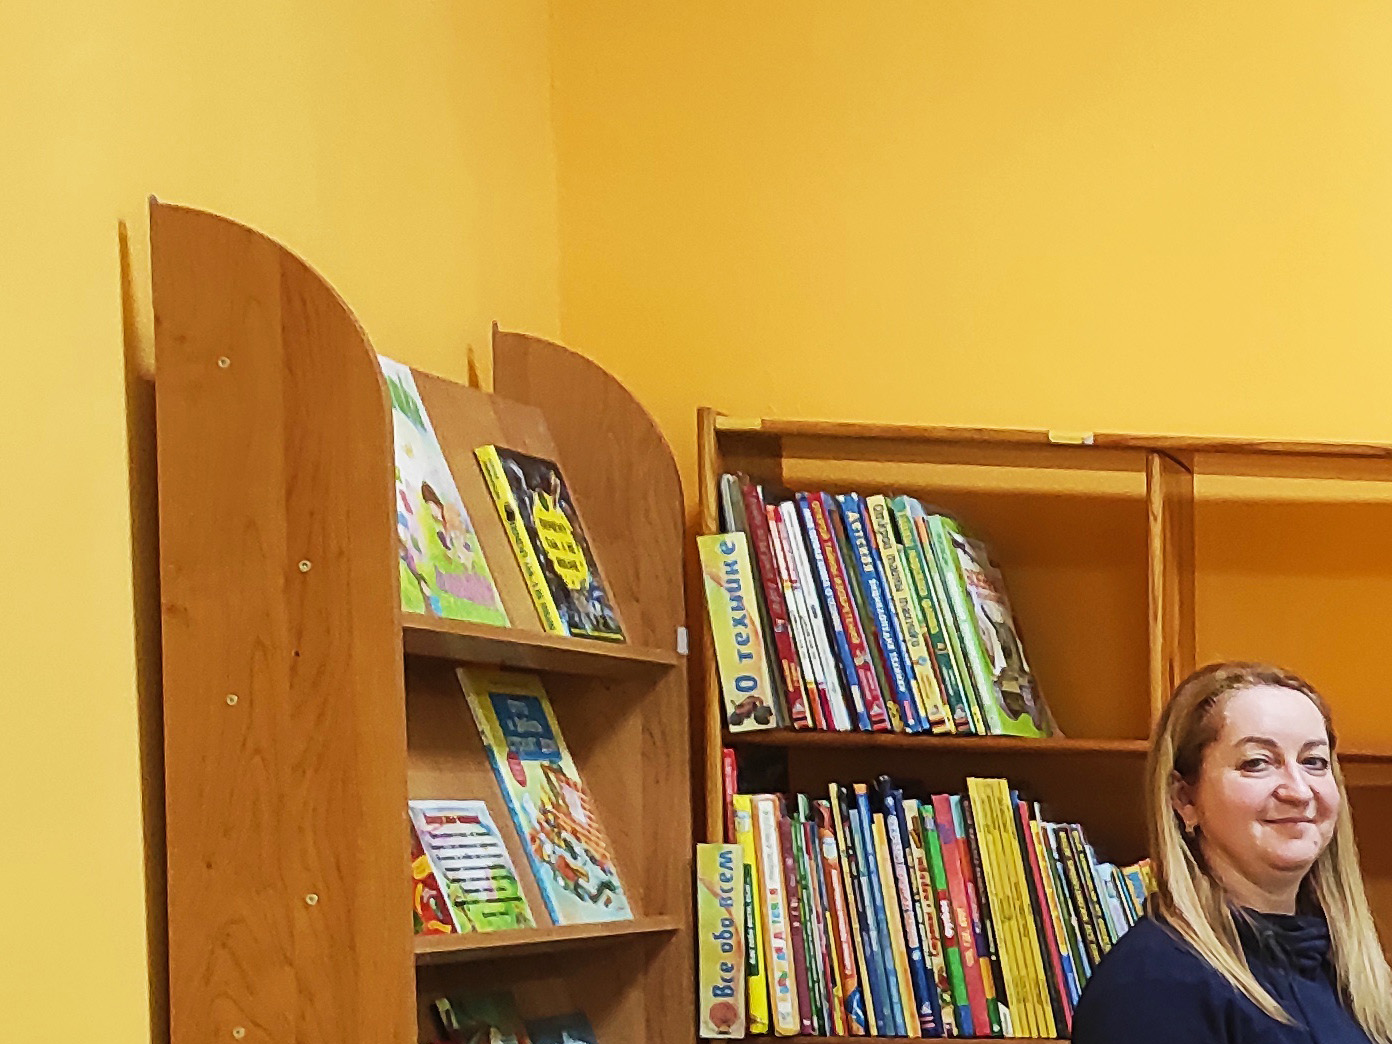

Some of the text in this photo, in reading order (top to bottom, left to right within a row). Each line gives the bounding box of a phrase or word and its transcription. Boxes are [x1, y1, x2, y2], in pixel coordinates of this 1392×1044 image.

[720, 539, 758, 693] О технике
[713, 850, 734, 997] Все обо всем
